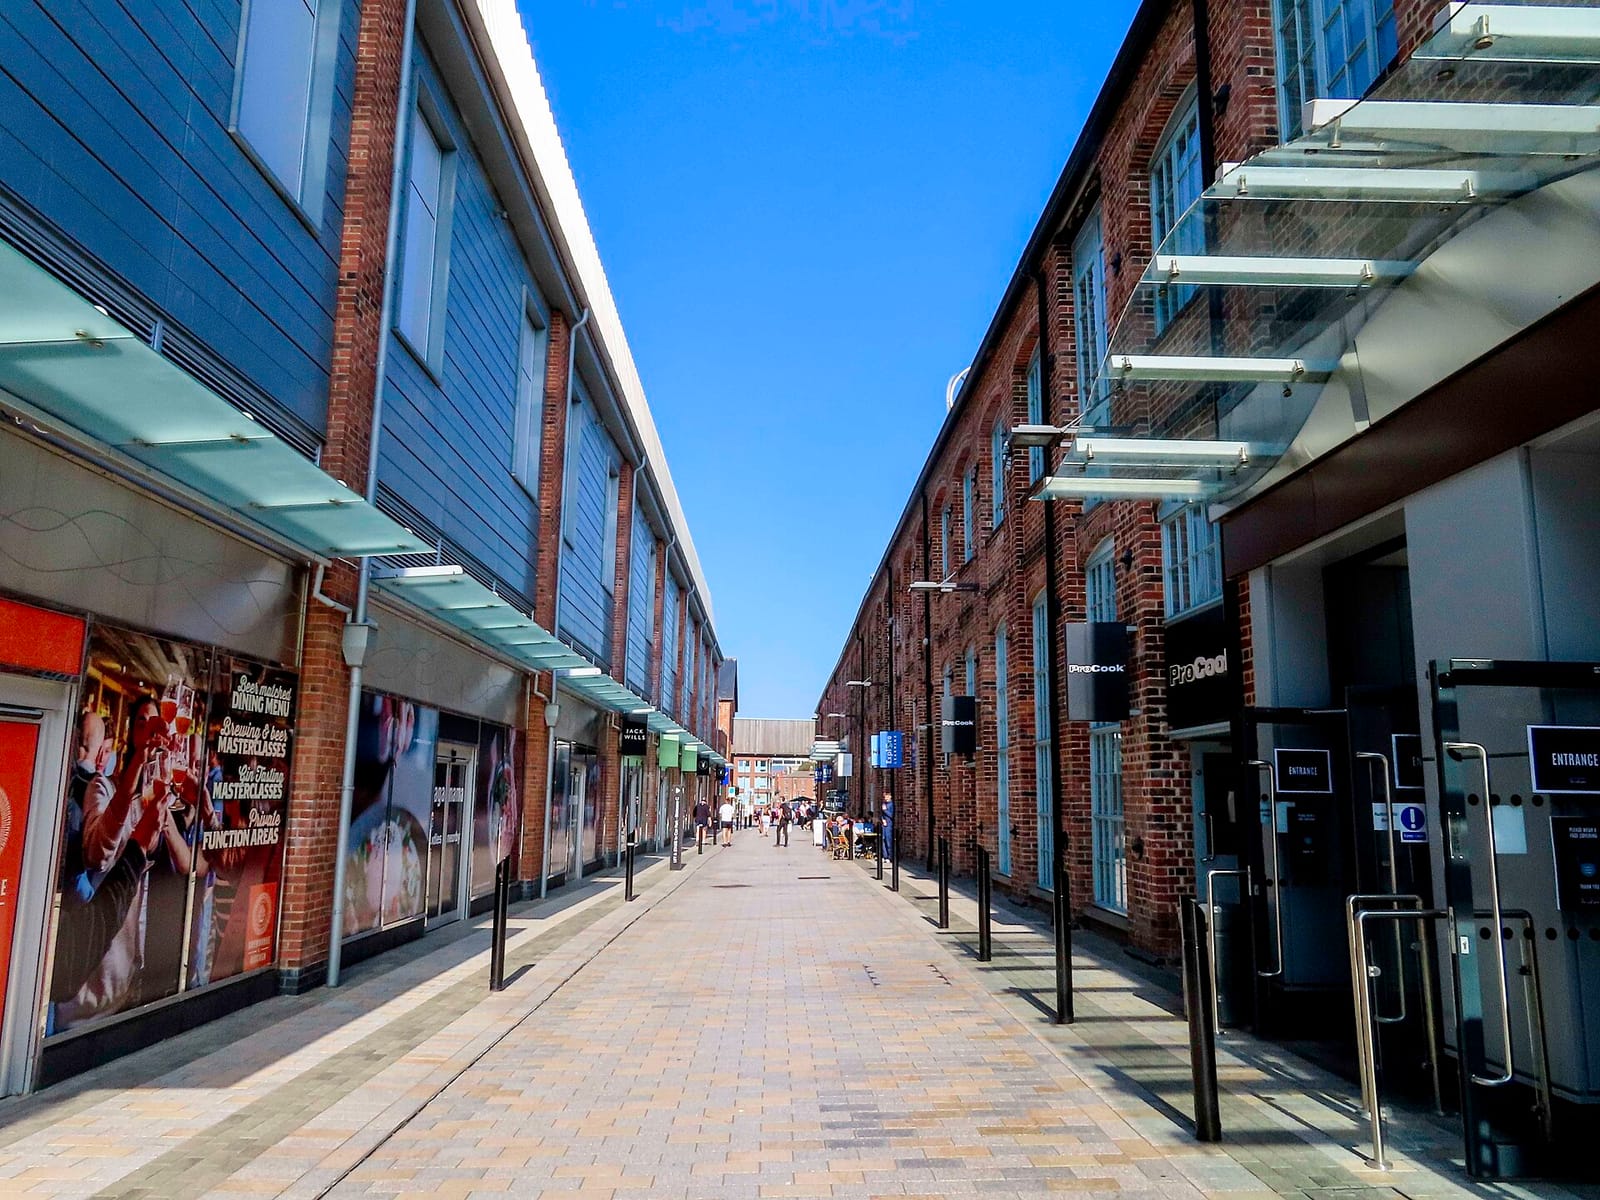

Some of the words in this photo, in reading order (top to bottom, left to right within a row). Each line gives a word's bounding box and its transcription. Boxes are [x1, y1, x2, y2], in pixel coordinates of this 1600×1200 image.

[1069, 664, 1125, 673] ProCook
[237, 674, 259, 695] Beer
[259, 684, 292, 701] matched
[231, 691, 264, 713] DINING
[265, 697, 290, 717] MENU
[220, 716, 261, 740] Brewing
[262, 723, 269, 740] &
[270, 725, 288, 742] beer
[217, 735, 286, 758] MASTERCLASSES
[1552, 752, 1599, 767] ENTRANCE
[238, 764, 255, 784] Gin
[256, 765, 284, 785] Tasting
[1288, 766, 1318, 776] ENTRANCE
[212, 781, 283, 800] MASTERCLASSES
[249, 808, 280, 828] Private
[202, 829, 250, 850] FUNCTION
[250, 827, 279, 846] AREAS
